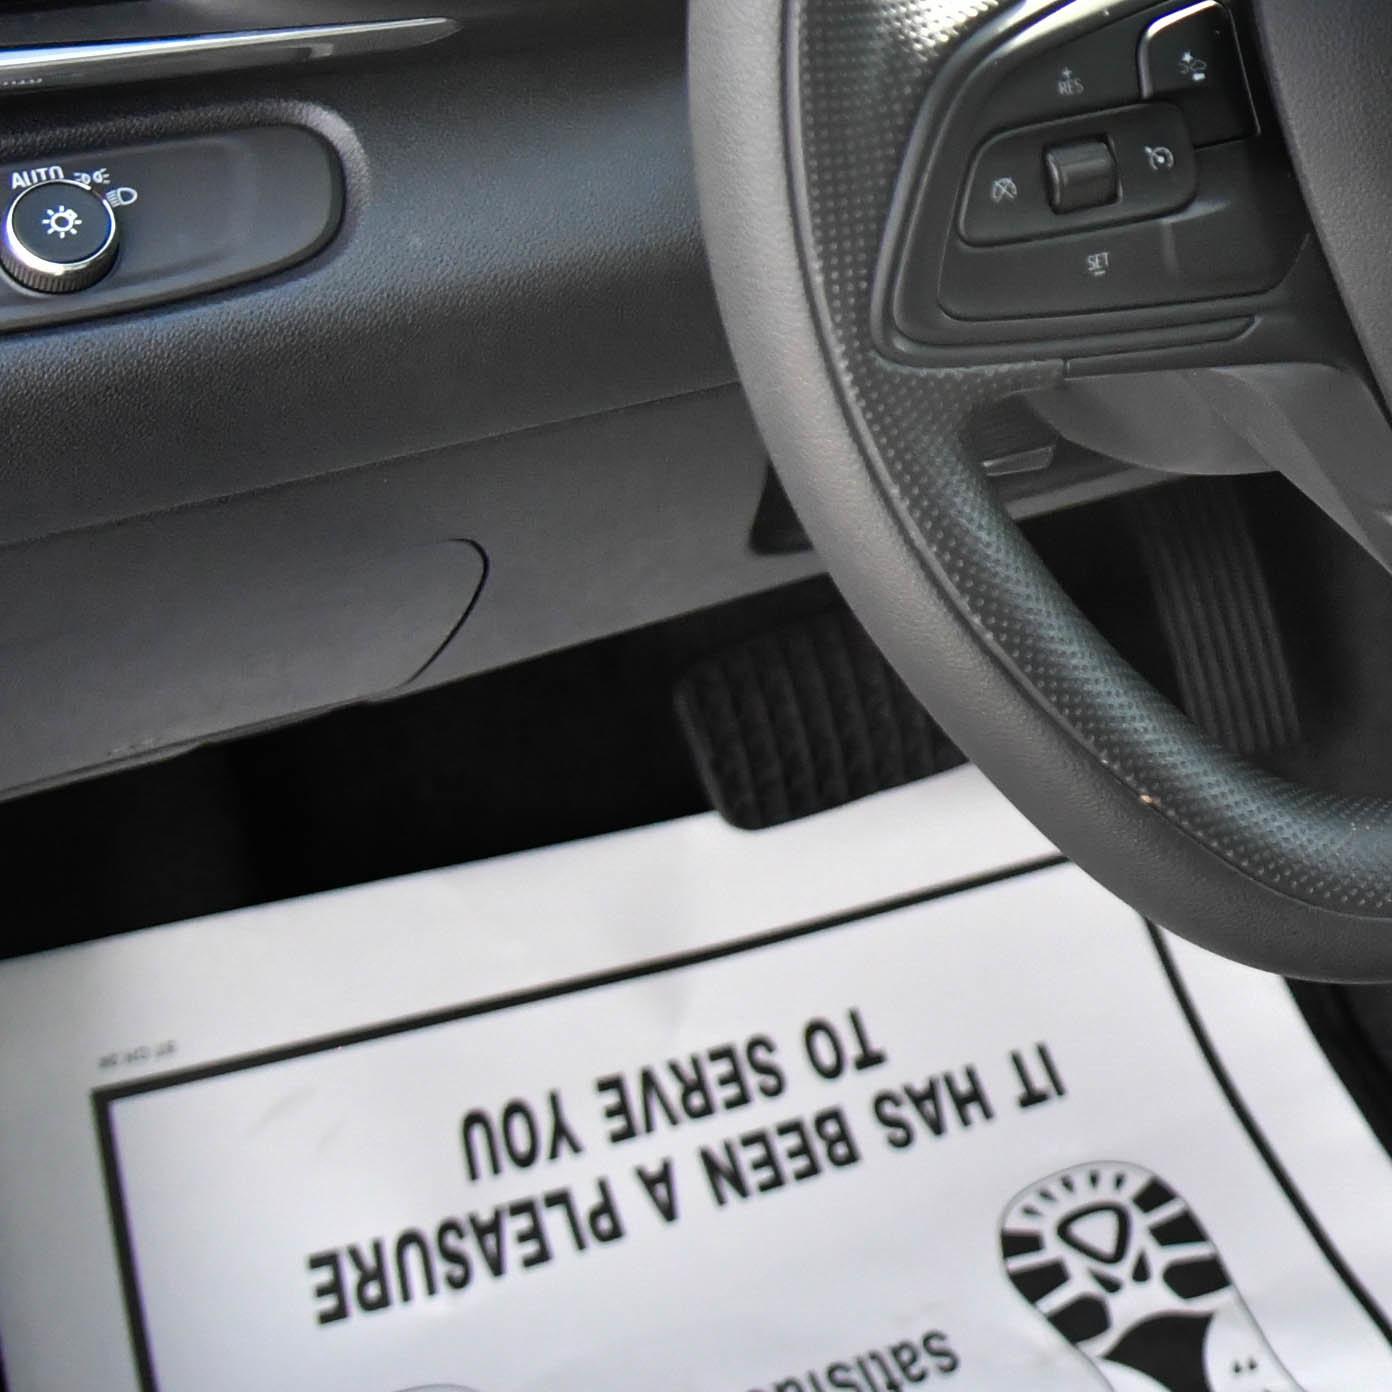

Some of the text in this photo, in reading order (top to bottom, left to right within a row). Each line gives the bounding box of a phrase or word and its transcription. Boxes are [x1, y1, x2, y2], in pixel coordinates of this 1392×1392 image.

[1057, 78, 1084, 95] RES
[12, 166, 64, 189] AUTO
[1087, 252, 1110, 271] SET
[459, 1006, 888, 1182] TO SERVE YOU
[306, 1040, 1068, 1327] IT HAS BEEN A PLEASURE
